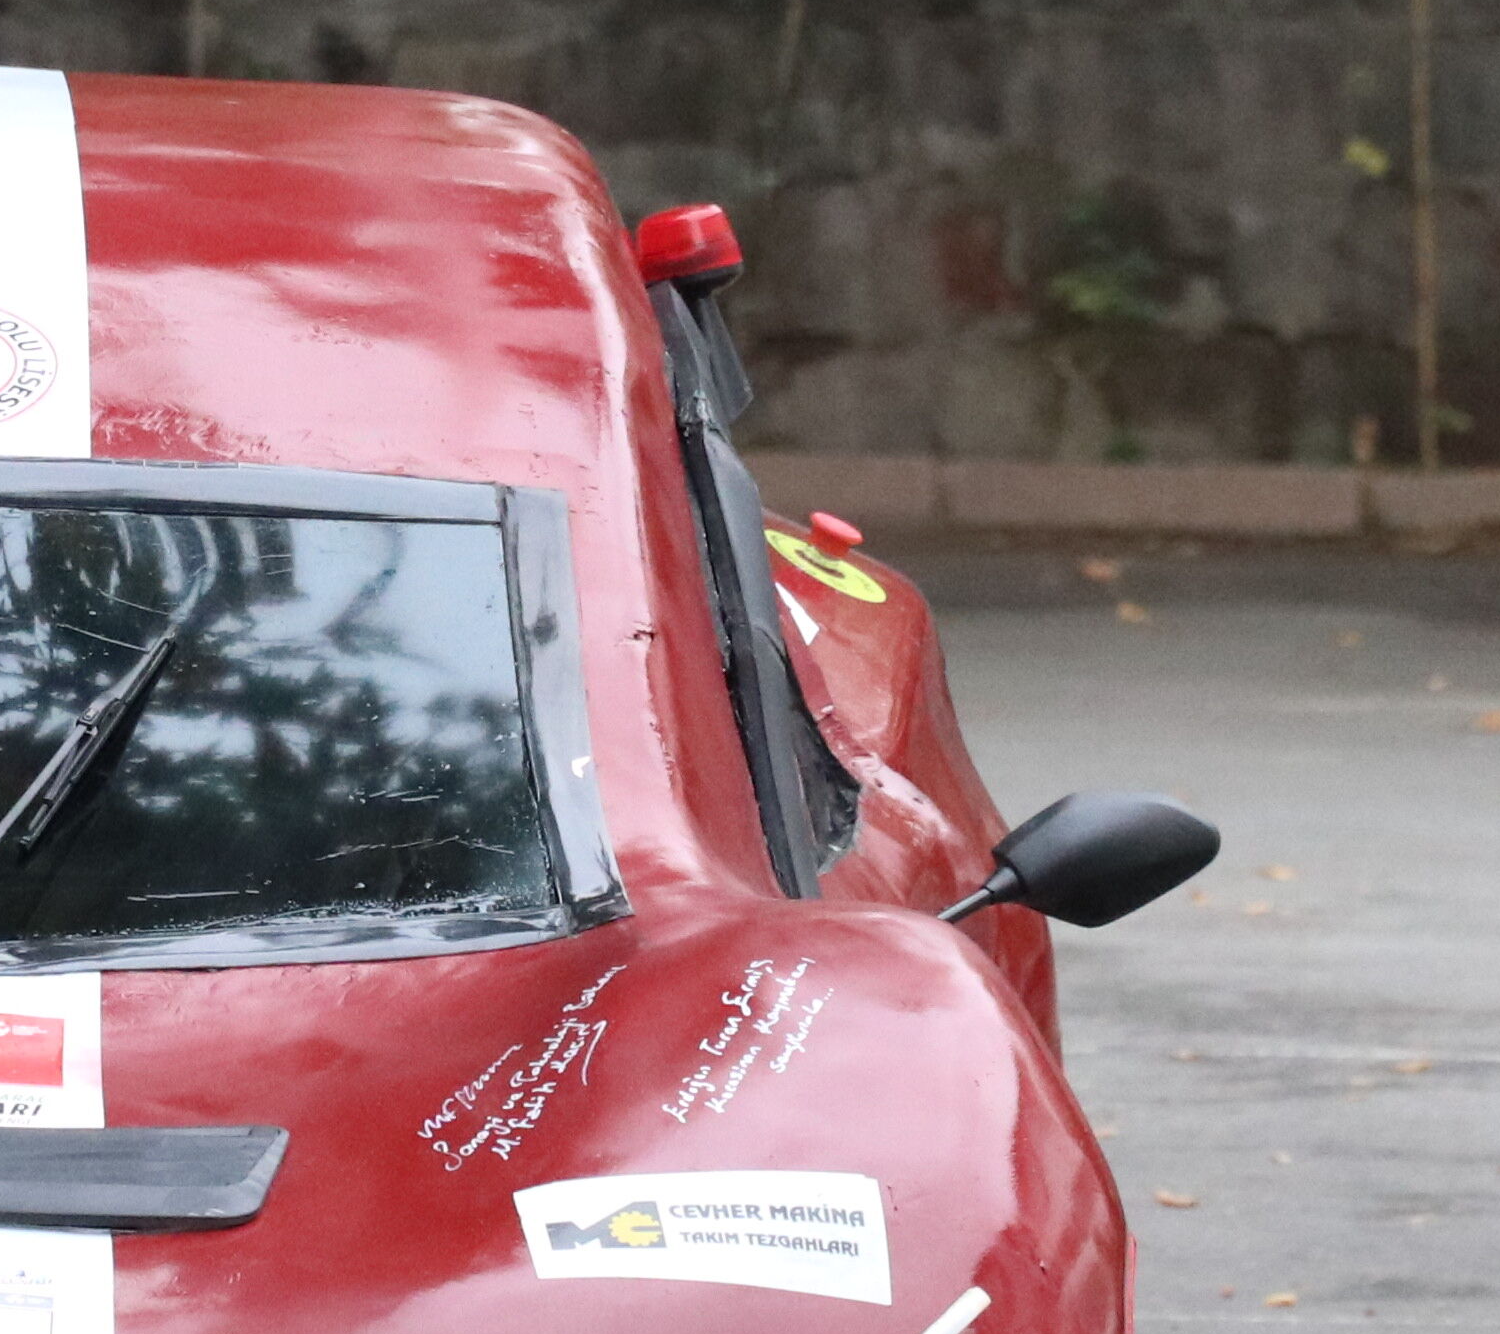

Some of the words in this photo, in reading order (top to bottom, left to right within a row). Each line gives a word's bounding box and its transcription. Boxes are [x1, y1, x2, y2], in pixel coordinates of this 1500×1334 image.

[668, 1203, 765, 1221] CEVHER
[769, 1203, 866, 1228] MAKİNA
[680, 1230, 740, 1245] TAKIM
[744, 1232, 860, 1257] TEZGAHLARI
